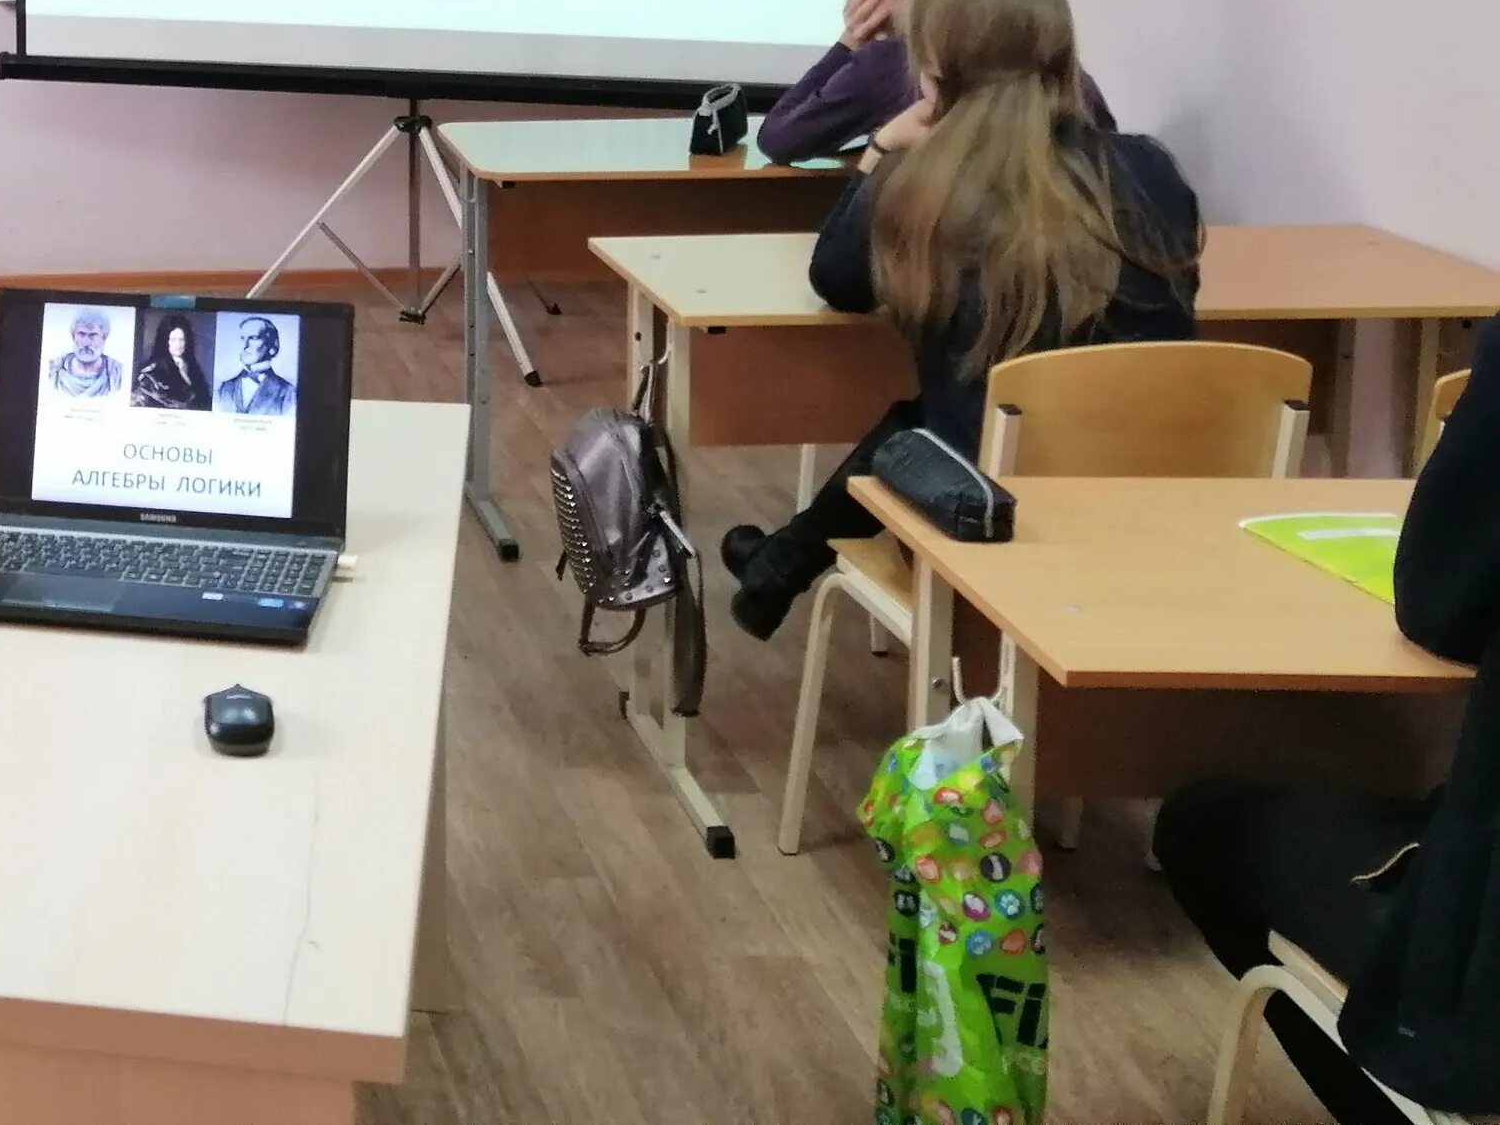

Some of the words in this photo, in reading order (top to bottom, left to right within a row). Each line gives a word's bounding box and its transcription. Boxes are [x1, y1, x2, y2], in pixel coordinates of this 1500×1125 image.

[123, 443, 213, 464] ОСНОВЫ
[72, 469, 165, 491] АЛГЕБРЫ
[176, 477, 261, 497] ЛОГИКИ
